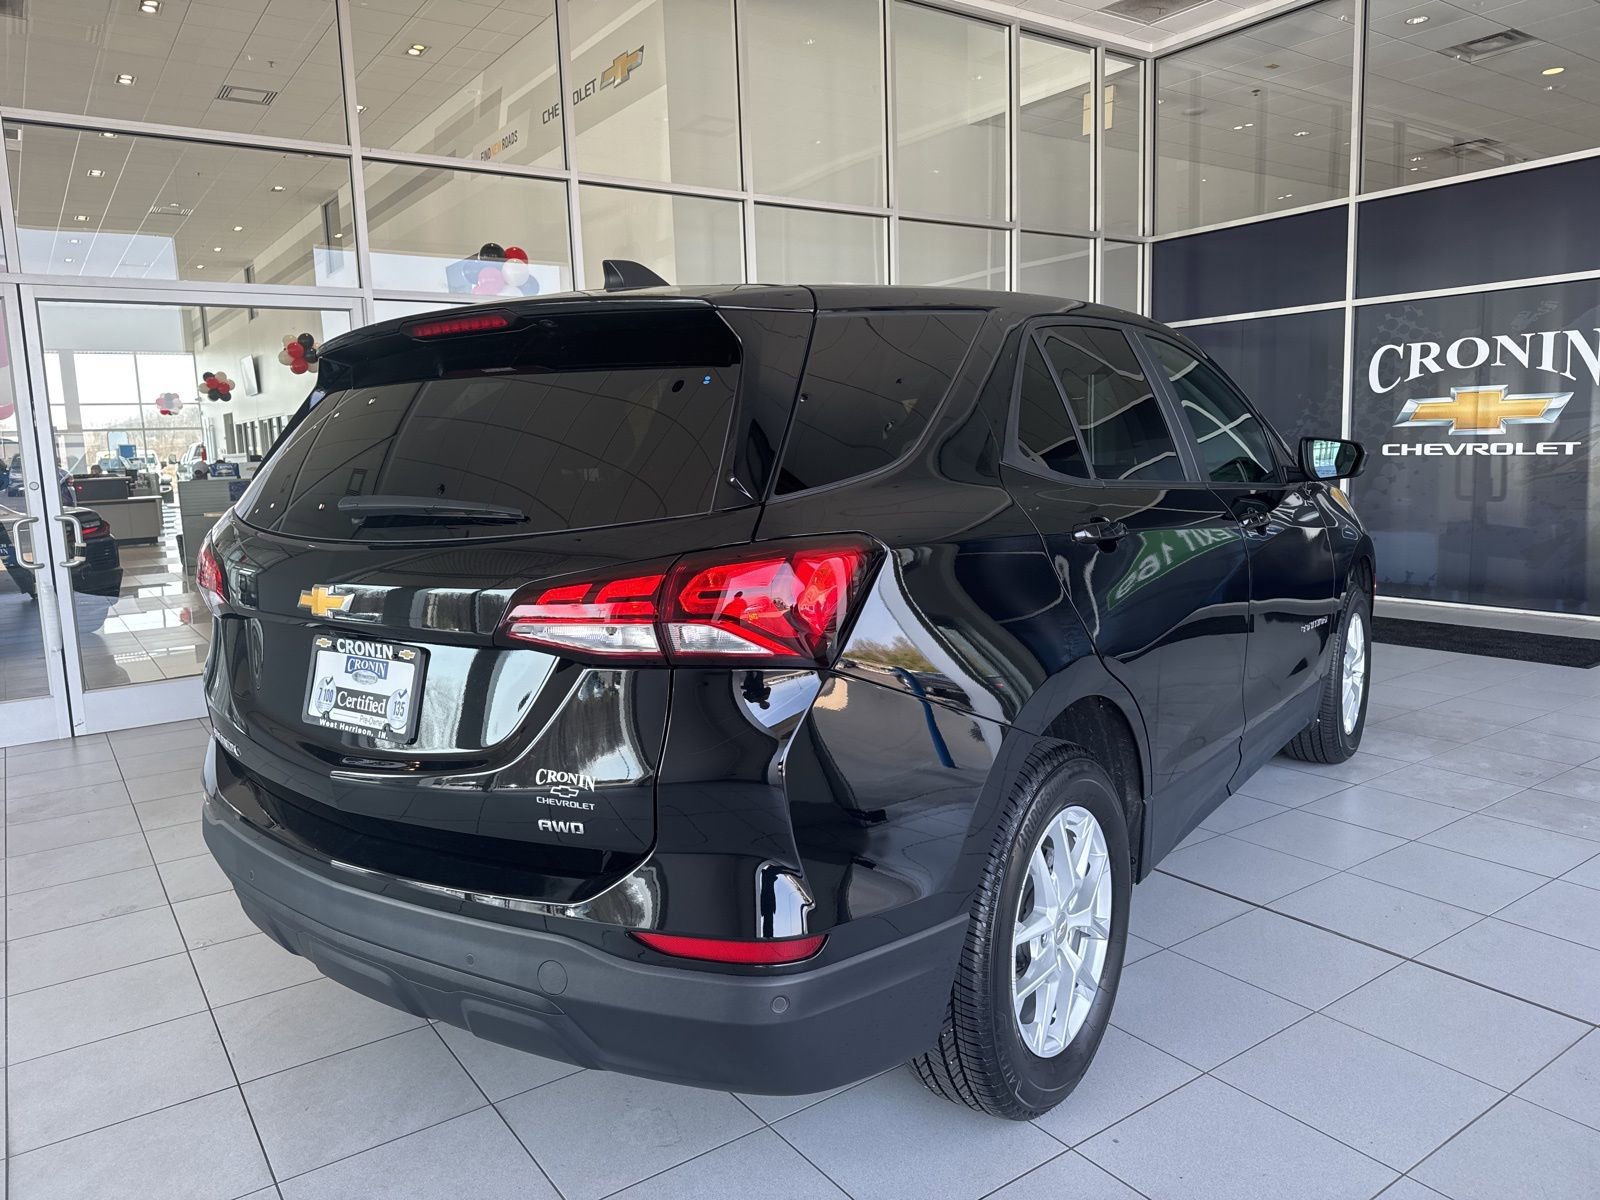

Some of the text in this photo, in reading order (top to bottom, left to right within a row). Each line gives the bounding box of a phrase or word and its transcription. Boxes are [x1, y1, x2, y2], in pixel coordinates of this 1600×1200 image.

[542, 78, 597, 124] CHEOLET
[502, 130, 518, 151] ROADS
[1368, 327, 1600, 394] CRONIN
[1381, 441, 1582, 456] CHEVROLET
[336, 639, 393, 660] CRONIN
[347, 658, 387, 678] CRONIN
[337, 690, 386, 714] Certified
[319, 718, 338, 729] West
[535, 768, 596, 792] CRONIN
[536, 796, 595, 811] CHEVROLET
[537, 819, 584, 835] AWD
